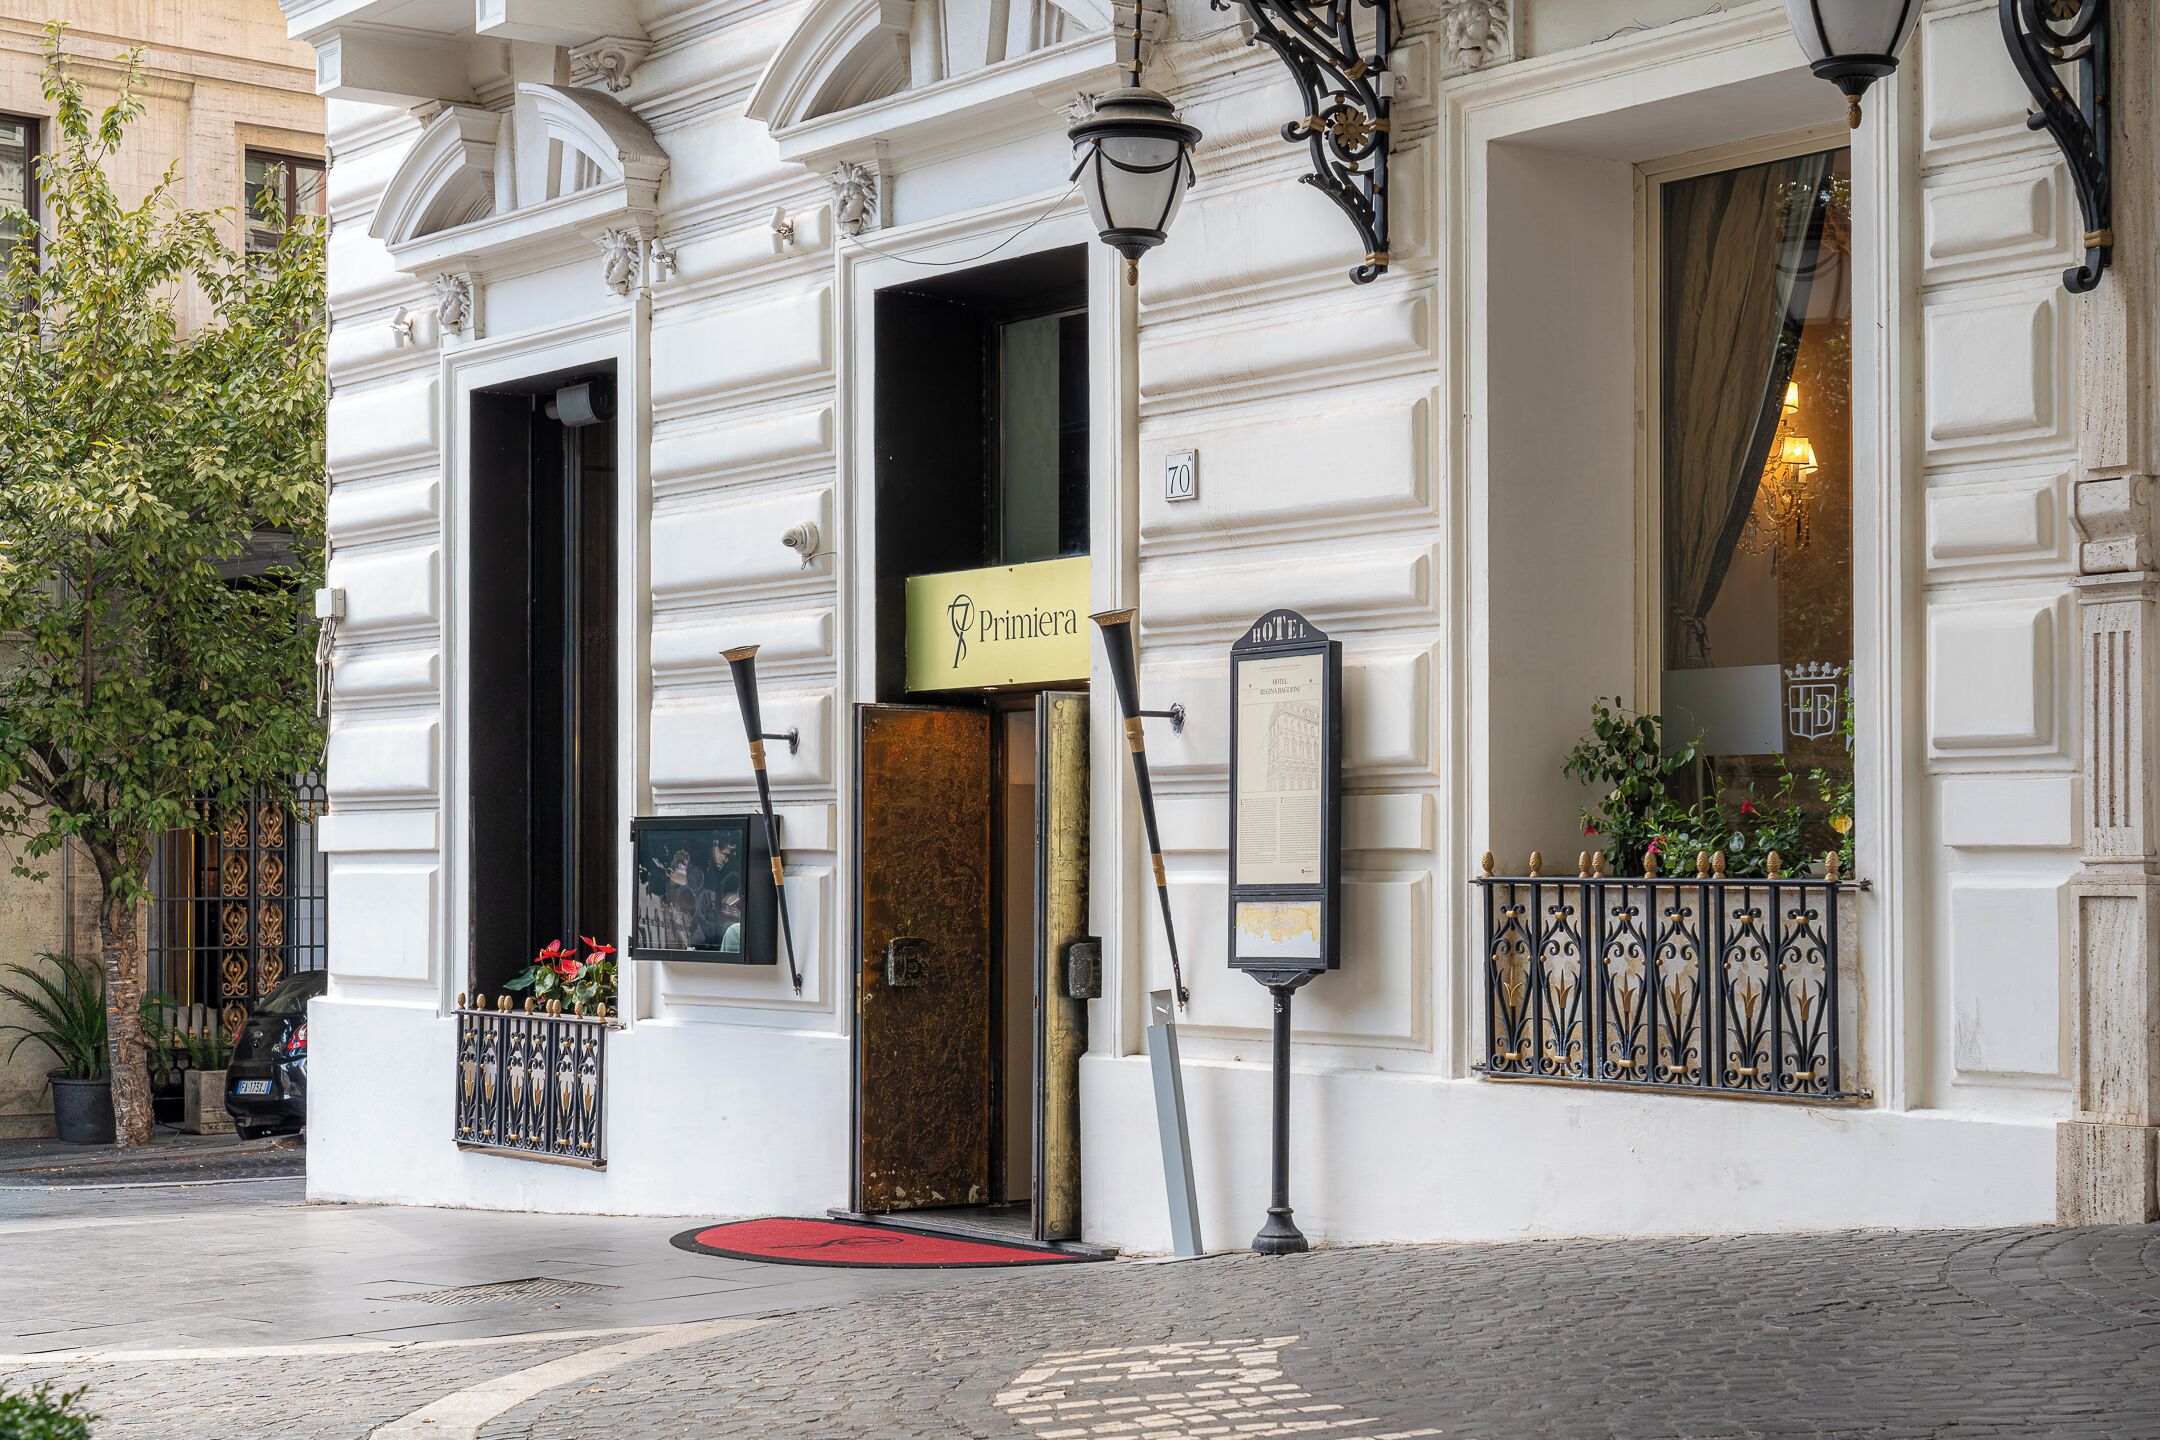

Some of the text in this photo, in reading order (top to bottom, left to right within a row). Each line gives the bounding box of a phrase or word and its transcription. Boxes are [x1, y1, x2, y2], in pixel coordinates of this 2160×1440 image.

[1168, 464, 1190, 494] 70
[979, 606, 1078, 643] Primiera
[1253, 616, 1306, 642] HOTEL
[1272, 678, 1288, 686] HOTEL
